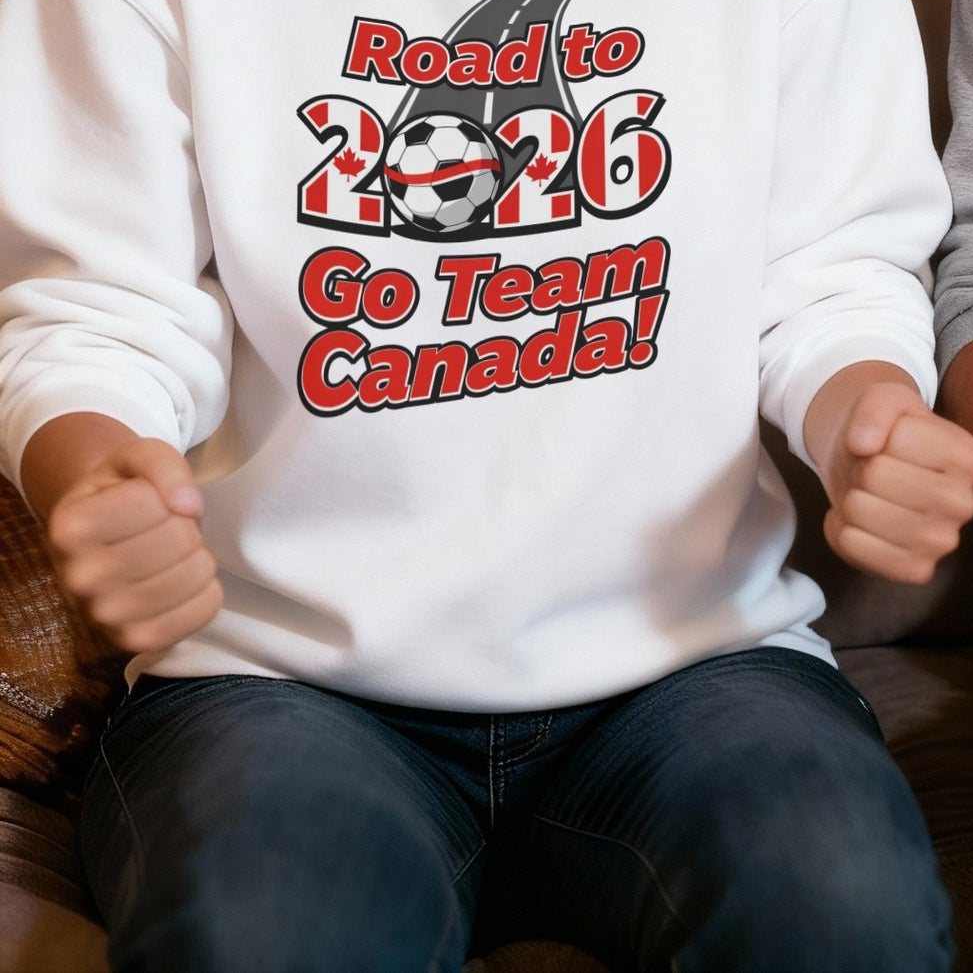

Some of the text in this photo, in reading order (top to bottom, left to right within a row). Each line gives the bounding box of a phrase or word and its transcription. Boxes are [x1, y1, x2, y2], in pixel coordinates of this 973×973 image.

[342, 16, 645, 88] Road to
[297, 89, 672, 242] 2026
[298, 236, 671, 329] Go Team
[298, 289, 670, 417] Canada!
